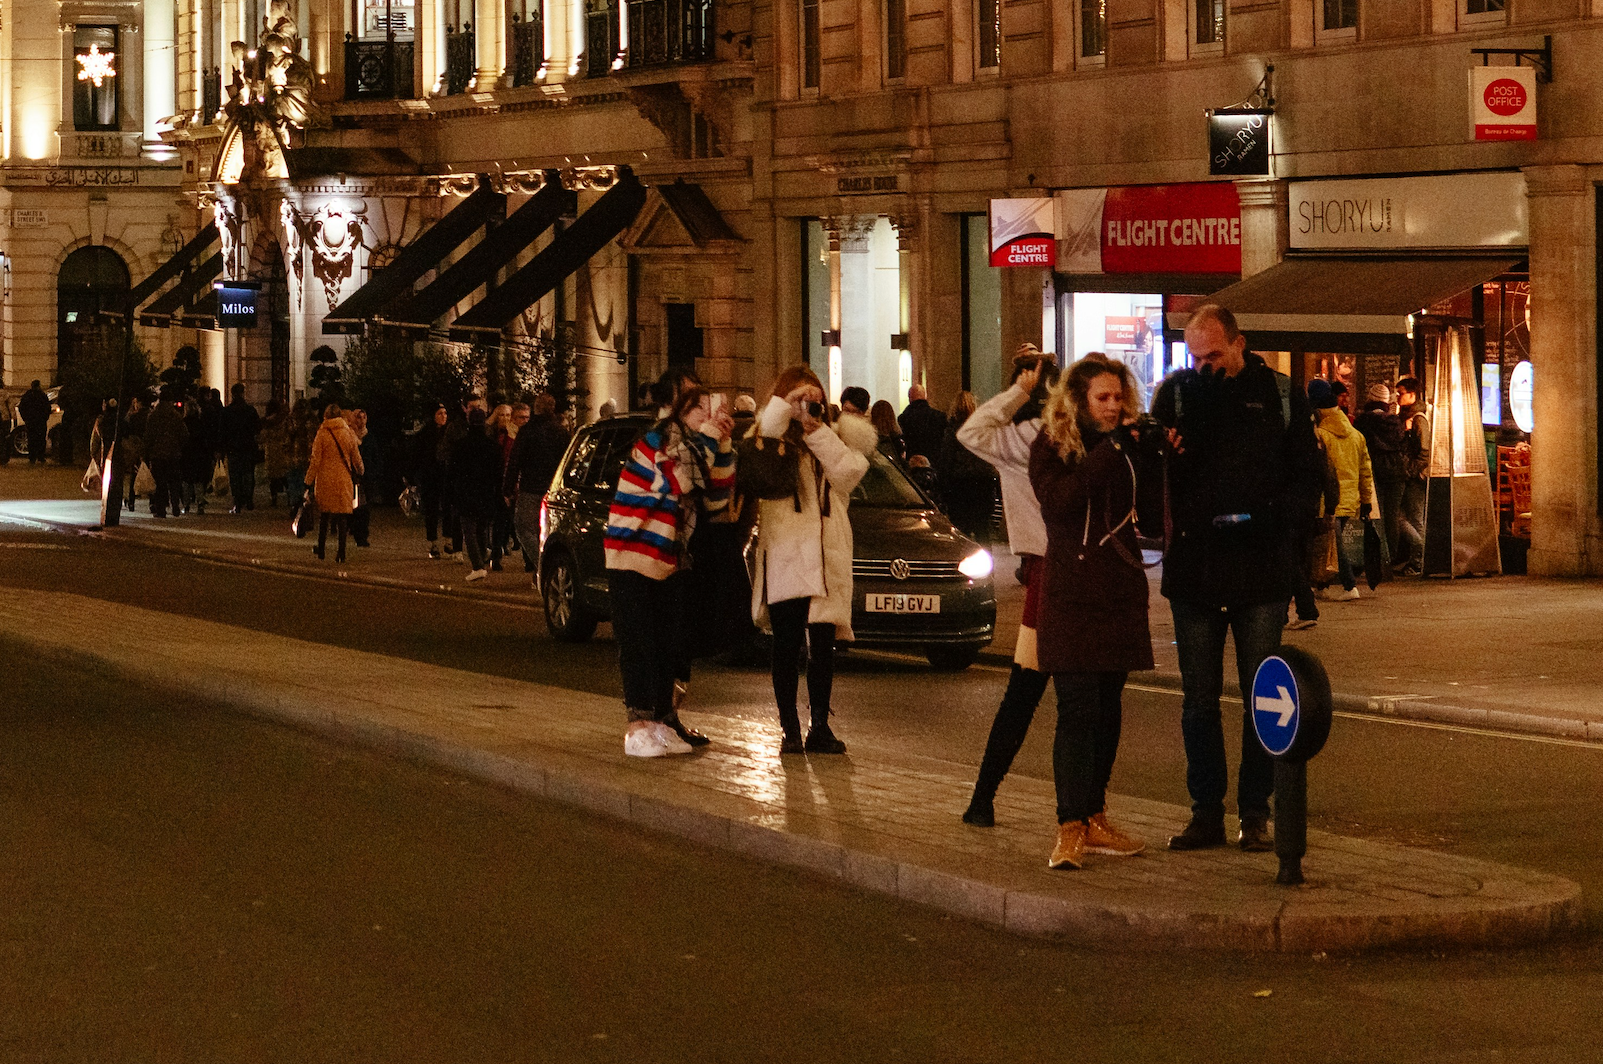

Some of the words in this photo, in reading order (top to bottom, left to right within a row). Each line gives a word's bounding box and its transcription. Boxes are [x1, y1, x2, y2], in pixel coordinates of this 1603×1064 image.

[1493, 86, 1517, 96] POST
[1488, 97, 1522, 107] OFFICE
[1215, 115, 1263, 168] SHORYU
[1237, 139, 1257, 161] RAMEN
[1299, 199, 1384, 233] SHORYU
[1107, 219, 1168, 246] FLIGHT
[1170, 217, 1239, 246] CENTRE
[1011, 244, 1048, 253] FLIGHT
[1008, 254, 1048, 263] CENTRE
[222, 303, 254, 314] Milos
[875, 597, 905, 611] LF19
[908, 598, 933, 611] GVJ
